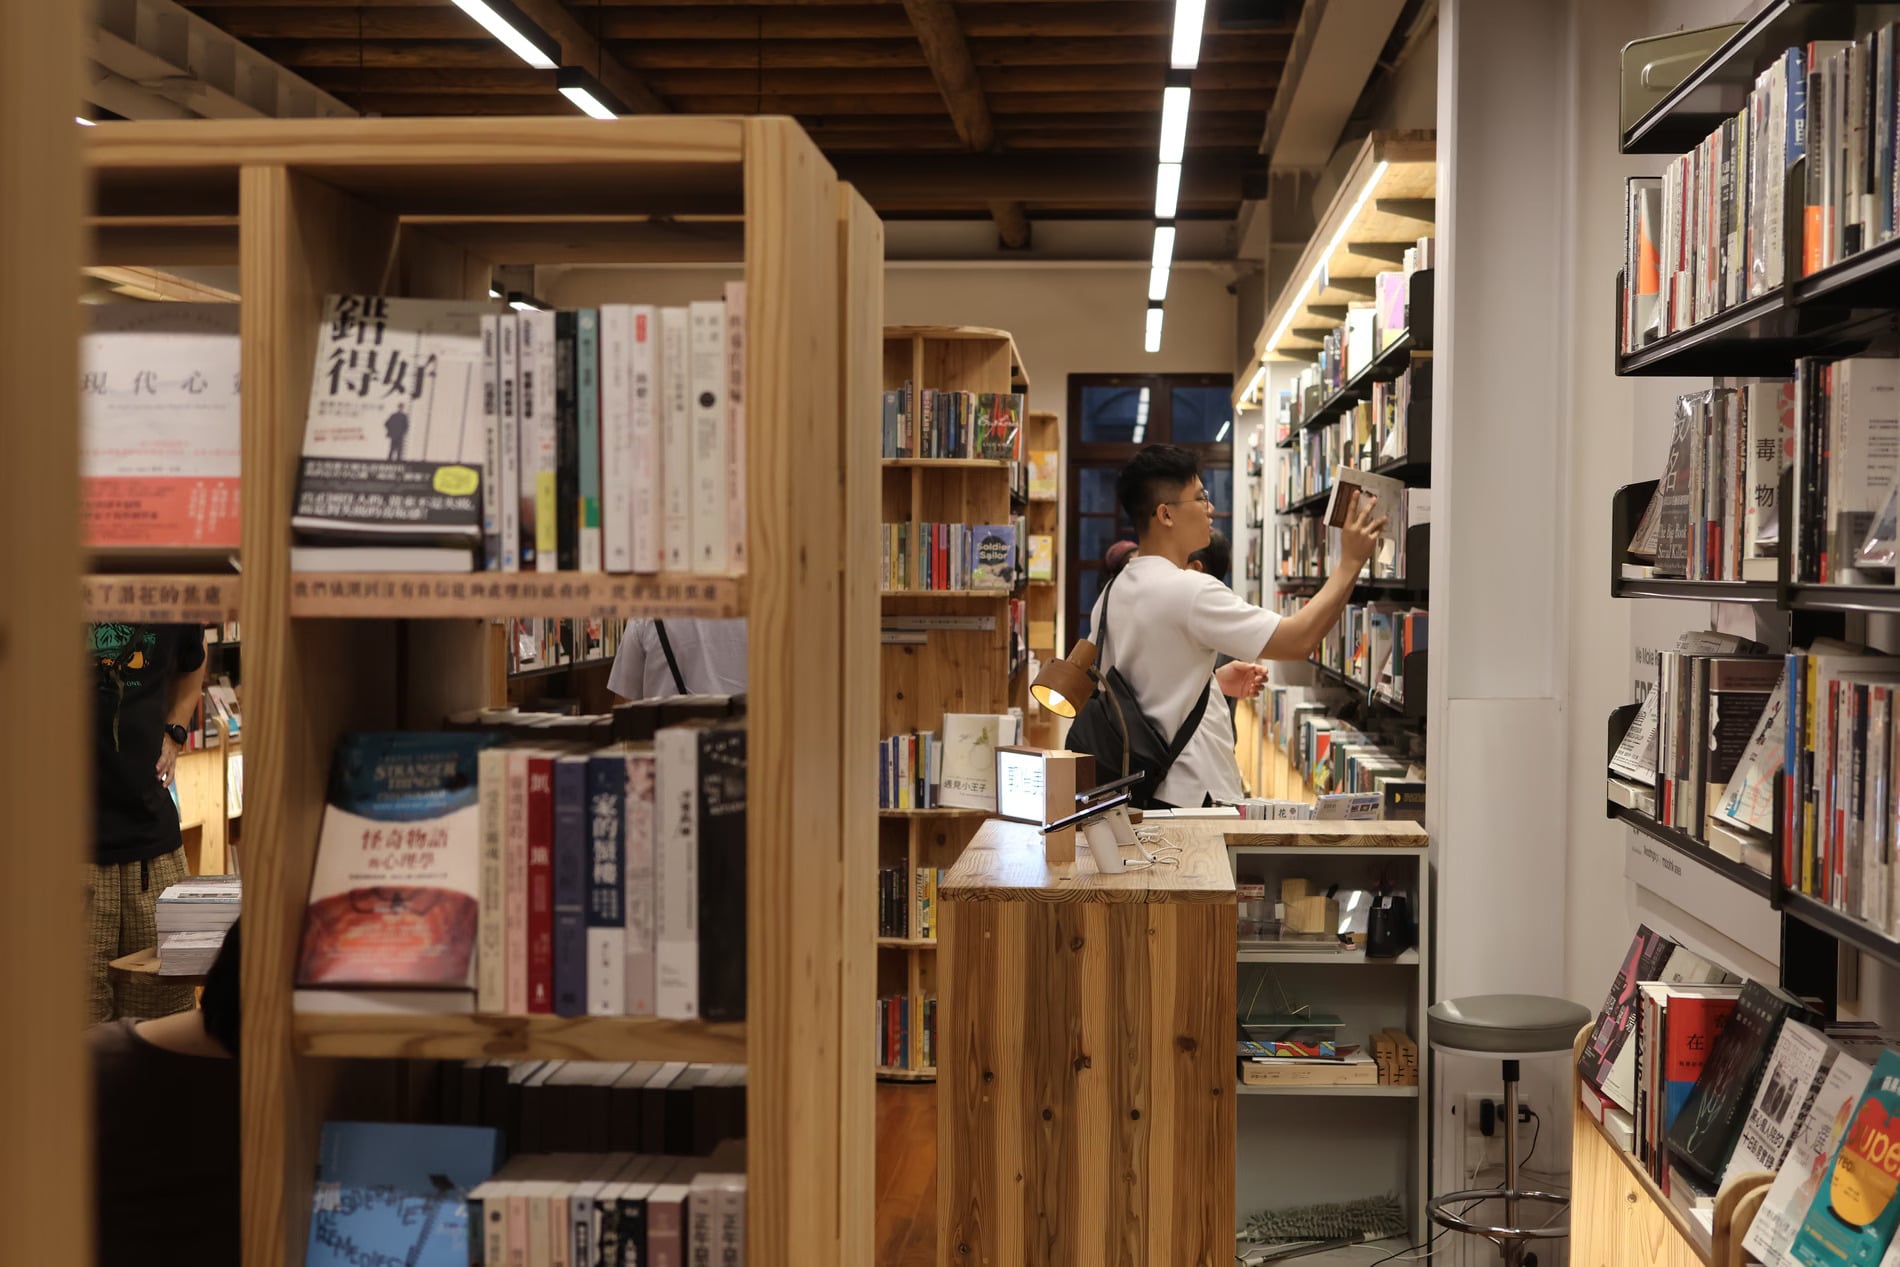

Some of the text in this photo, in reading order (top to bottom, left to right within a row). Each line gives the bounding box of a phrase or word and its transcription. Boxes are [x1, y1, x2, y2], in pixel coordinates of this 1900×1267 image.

[327, 348, 438, 399] 得好
[976, 542, 1011, 551] Soldier
[979, 551, 1008, 561] Sailor
[943, 780, 987, 792] 遇見小王子
[1687, 1033, 1705, 1050] 在
